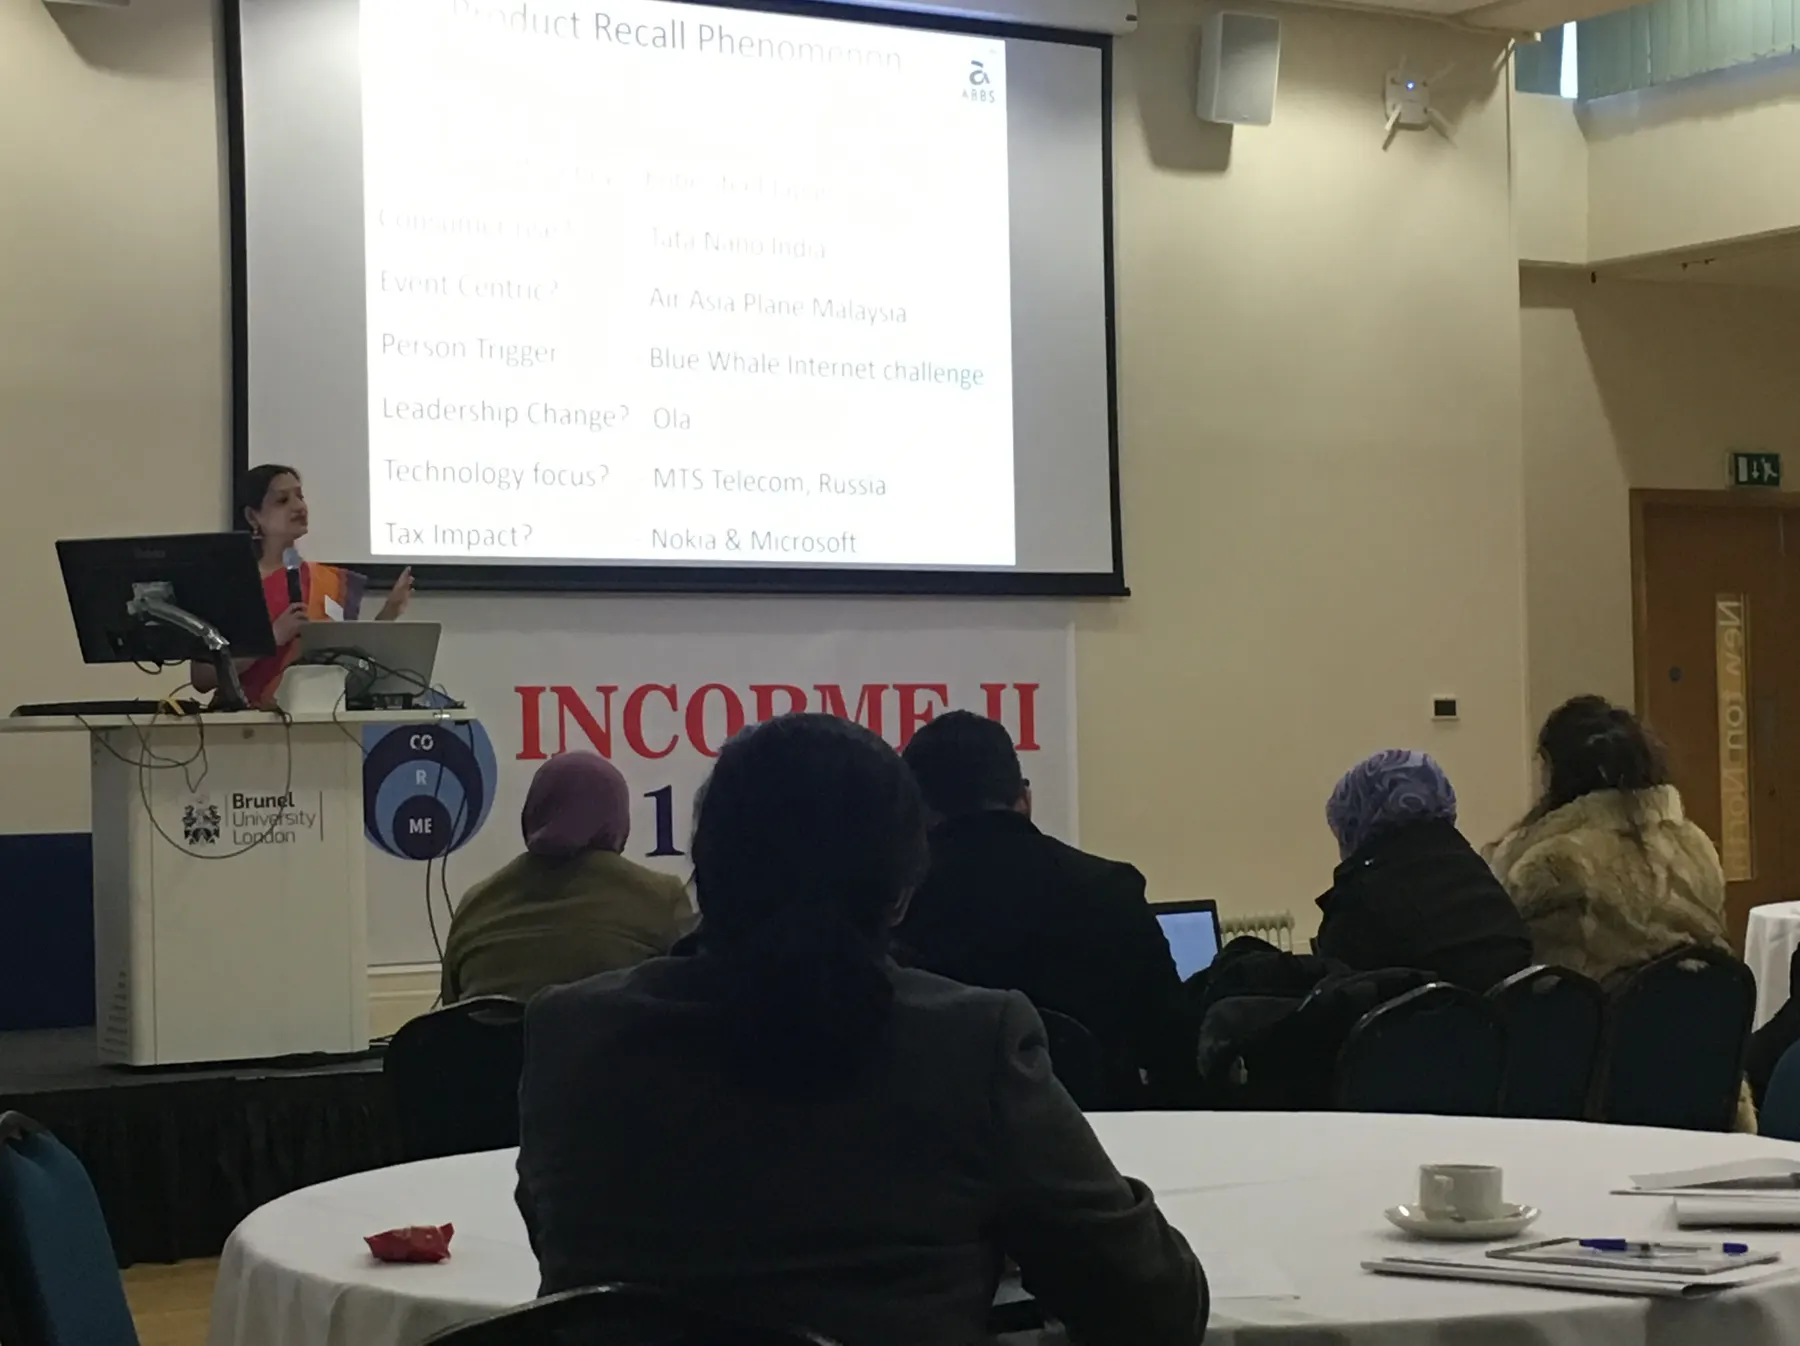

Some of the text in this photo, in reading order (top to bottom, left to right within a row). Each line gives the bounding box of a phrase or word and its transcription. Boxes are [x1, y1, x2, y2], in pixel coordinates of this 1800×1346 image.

[453, 0, 902, 72] Pduct Recall Phenomenon
[962, 84, 996, 103] ABBS
[379, 209, 502, 233] Conumr
[653, 228, 825, 258] Tata Nano India
[381, 270, 558, 300] Event Centric?
[650, 288, 906, 326] Air Asia Plane Malaysia
[383, 333, 555, 367] Person Trigger
[651, 347, 984, 390] Blue Whale Internet challenge
[383, 397, 629, 432] Leadership Change?
[654, 407, 690, 430] Ola
[384, 459, 610, 491] Technology focus?
[654, 468, 886, 496] MTS Telecom, Russia
[385, 522, 533, 552] Tax Impact?
[652, 528, 856, 553] Nokia & Microsoft
[410, 734, 434, 750] CO
[416, 770, 427, 784] R
[233, 793, 295, 810] Brunel
[233, 811, 317, 829] University
[409, 818, 433, 834] ME
[233, 829, 296, 846] London
